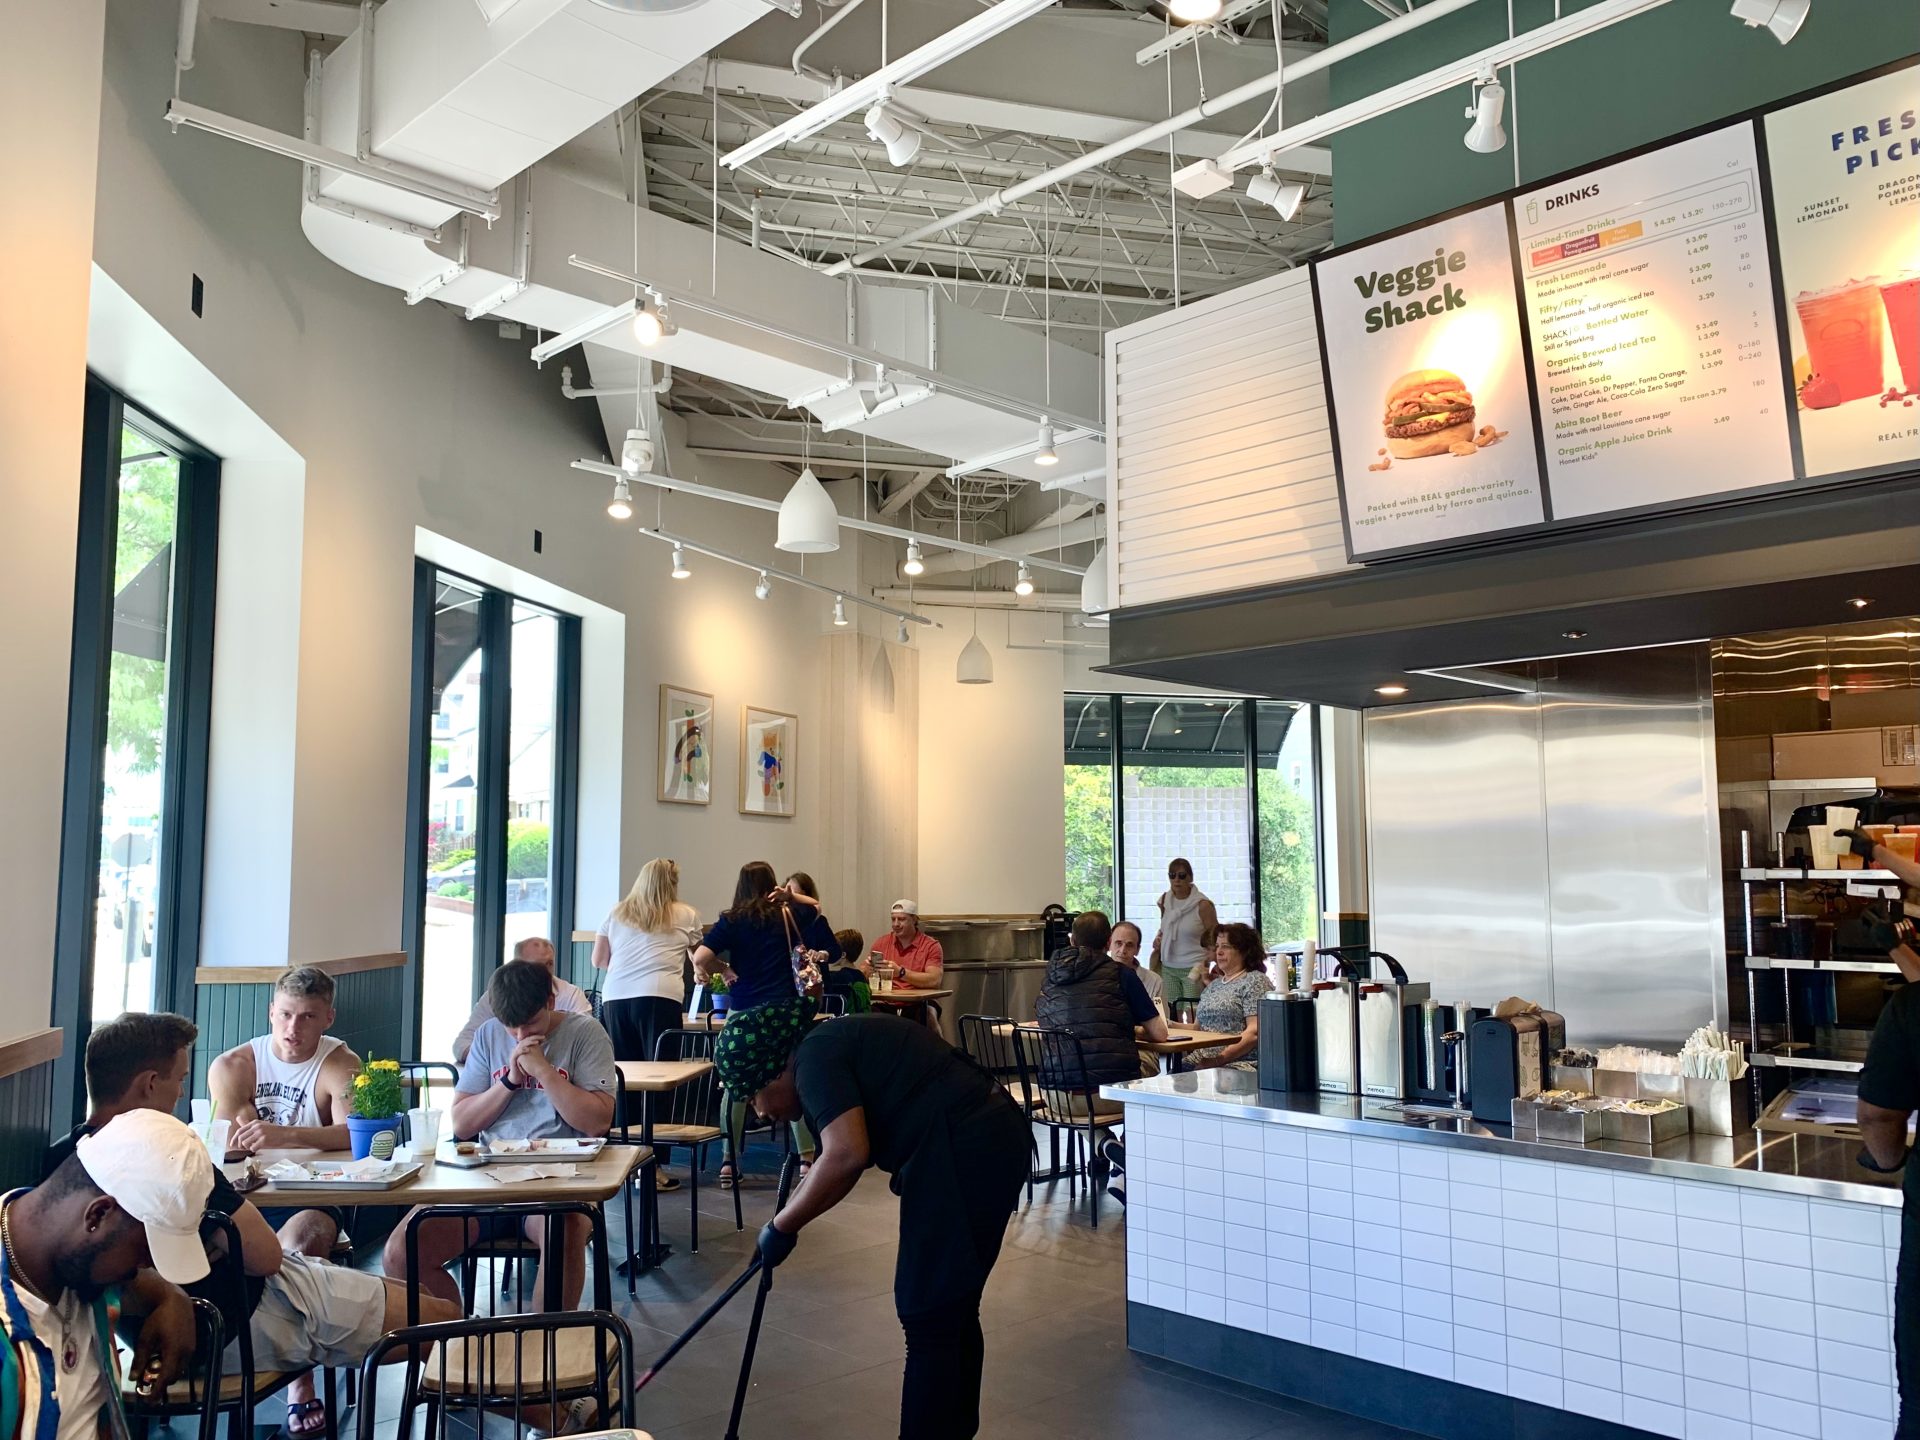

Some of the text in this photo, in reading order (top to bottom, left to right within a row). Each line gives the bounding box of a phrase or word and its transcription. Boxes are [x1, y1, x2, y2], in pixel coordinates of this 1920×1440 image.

[1727, 160, 1738, 168] Cal
[1546, 184, 1600, 210] DRINKS
[1804, 196, 1840, 212] SUNSET
[1890, 194, 1920, 206] LEMO
[1660, 217, 1676, 225] 4.29
[1797, 203, 1849, 223] LEMONADE
[1530, 218, 1616, 249] Limited-Time Drinks
[1566, 237, 1595, 250] Dragonfruit
[1692, 233, 1707, 242] 3.99
[1564, 244, 1598, 257] Pomegranate
[1694, 244, 1709, 254] 4.99
[1354, 248, 1466, 299] Veggie
[1536, 262, 1606, 287] Fresh Lemonade
[1538, 289, 1556, 298] Made
[1557, 282, 1583, 292] in-house
[1585, 277, 1597, 285] with
[1631, 262, 1649, 272] sugar
[1696, 263, 1711, 272] 3.99
[1697, 274, 1712, 283] 4.99
[1365, 282, 1466, 333] Shack
[1541, 316, 1554, 325] Half
[1588, 304, 1601, 312] half
[1603, 298, 1626, 309] organic
[1628, 292, 1642, 301] iced
[1644, 290, 1654, 298] tea
[1542, 330, 1568, 342] SHACK
[1586, 316, 1618, 330] Bottled
[1620, 309, 1649, 321] Water
[1699, 291, 1715, 301] 3.29
[1546, 353, 1580, 368] Organic
[1582, 344, 1617, 359] Brewed
[1619, 339, 1638, 349] Iced
[1640, 336, 1656, 344] Tea
[1702, 320, 1718, 329] 3.49
[1565, 335, 1594, 347] Sparkling
[1548, 367, 1570, 378] Brewed
[1572, 362, 1586, 371] fresh
[1588, 360, 1603, 369] daily
[1704, 331, 1720, 340] 3.99
[1550, 380, 1587, 394] Fountain
[1589, 374, 1612, 385] Soda
[1706, 348, 1722, 358] 3.49
[1551, 395, 1568, 405] Coke,
[1570, 392, 1582, 400] Diet
[1584, 389, 1601, 397] Coke,
[1603, 385, 1611, 393] Dr
[1613, 380, 1637, 392] Pepper,
[1639, 375, 1657, 385] Fanta
[1659, 369, 1687, 380] Orange,
[1707, 360, 1723, 369] 3.99
[1552, 405, 1571, 415] Sprite,
[1573, 399, 1594, 409] Ginger
[1610, 387, 1646, 400] Coca-Cola
[1647, 384, 1663, 392] Zero
[1665, 379, 1685, 389] Sugar
[1555, 419, 1578, 430] Abita
[1580, 414, 1600, 424] Root
[1602, 410, 1623, 420] Beer
[1680, 395, 1695, 403] 12oz
[1697, 392, 1709, 400] can
[1711, 387, 1727, 396] 3.79
[1556, 432, 1574, 440] Made
[1575, 428, 1588, 436] with
[1603, 419, 1633, 430] Louisiana
[1635, 415, 1650, 423] cane
[1652, 410, 1671, 421] sugar
[1558, 442, 1592, 456] Organic
[1594, 436, 1620, 450] Apple
[1622, 432, 1645, 443] Juice
[1647, 426, 1673, 438] Drink
[1714, 416, 1730, 424] 3.49
[1878, 431, 1903, 442] REAL
[1559, 457, 1580, 466] Honest
[1354, 515, 1387, 526] veggies
[1396, 505, 1435, 520] powered
[1437, 502, 1448, 513] by
[1450, 497, 1474, 508] farro
[1476, 493, 1494, 504] and
[1496, 487, 1532, 501] quinoa.
[1367, 478, 1515, 513] Packed with REAL garden-variety
[1367, 1086, 1385, 1094] nemco
